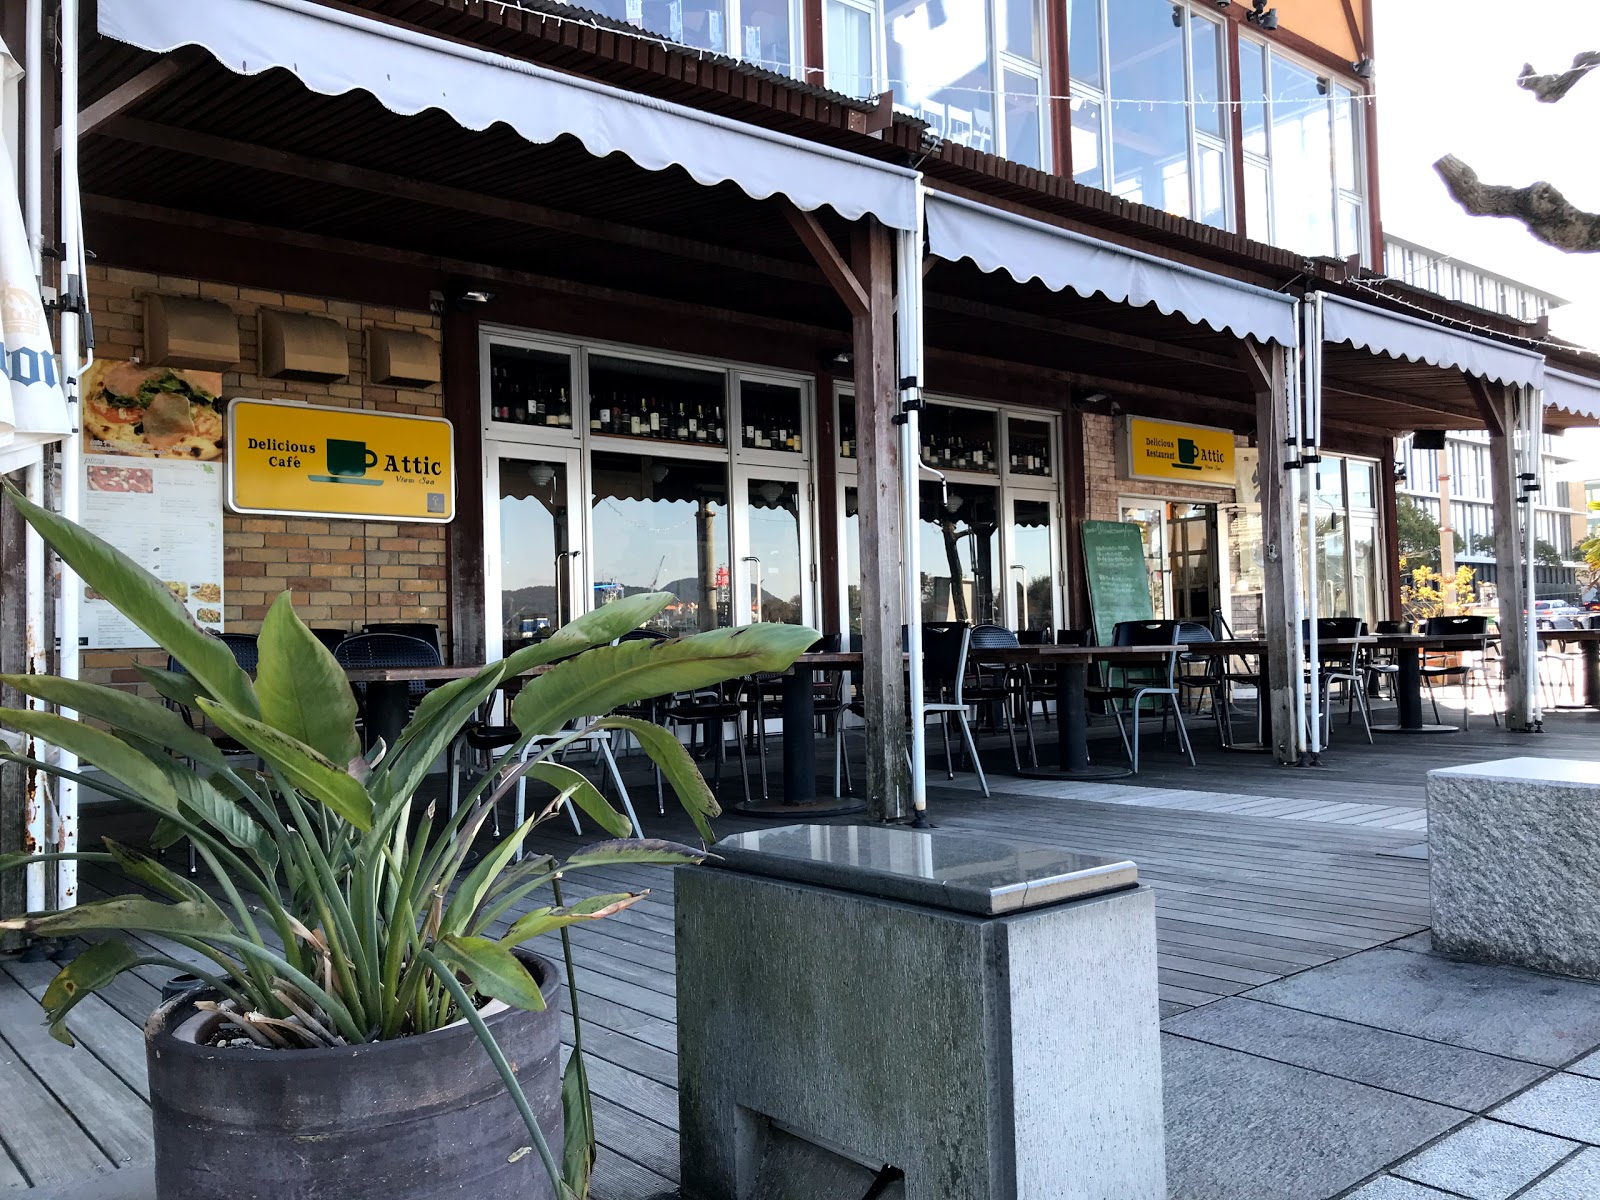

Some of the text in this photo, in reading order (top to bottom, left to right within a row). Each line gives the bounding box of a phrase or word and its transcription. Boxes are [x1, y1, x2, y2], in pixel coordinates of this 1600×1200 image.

[247, 437, 316, 454] Delicious
[1146, 438, 1174, 448] Delicious
[268, 455, 301, 469] Café
[1146, 449, 1175, 460] Restaurant
[1201, 448, 1225, 464] Attic
[383, 454, 442, 476] Attic
